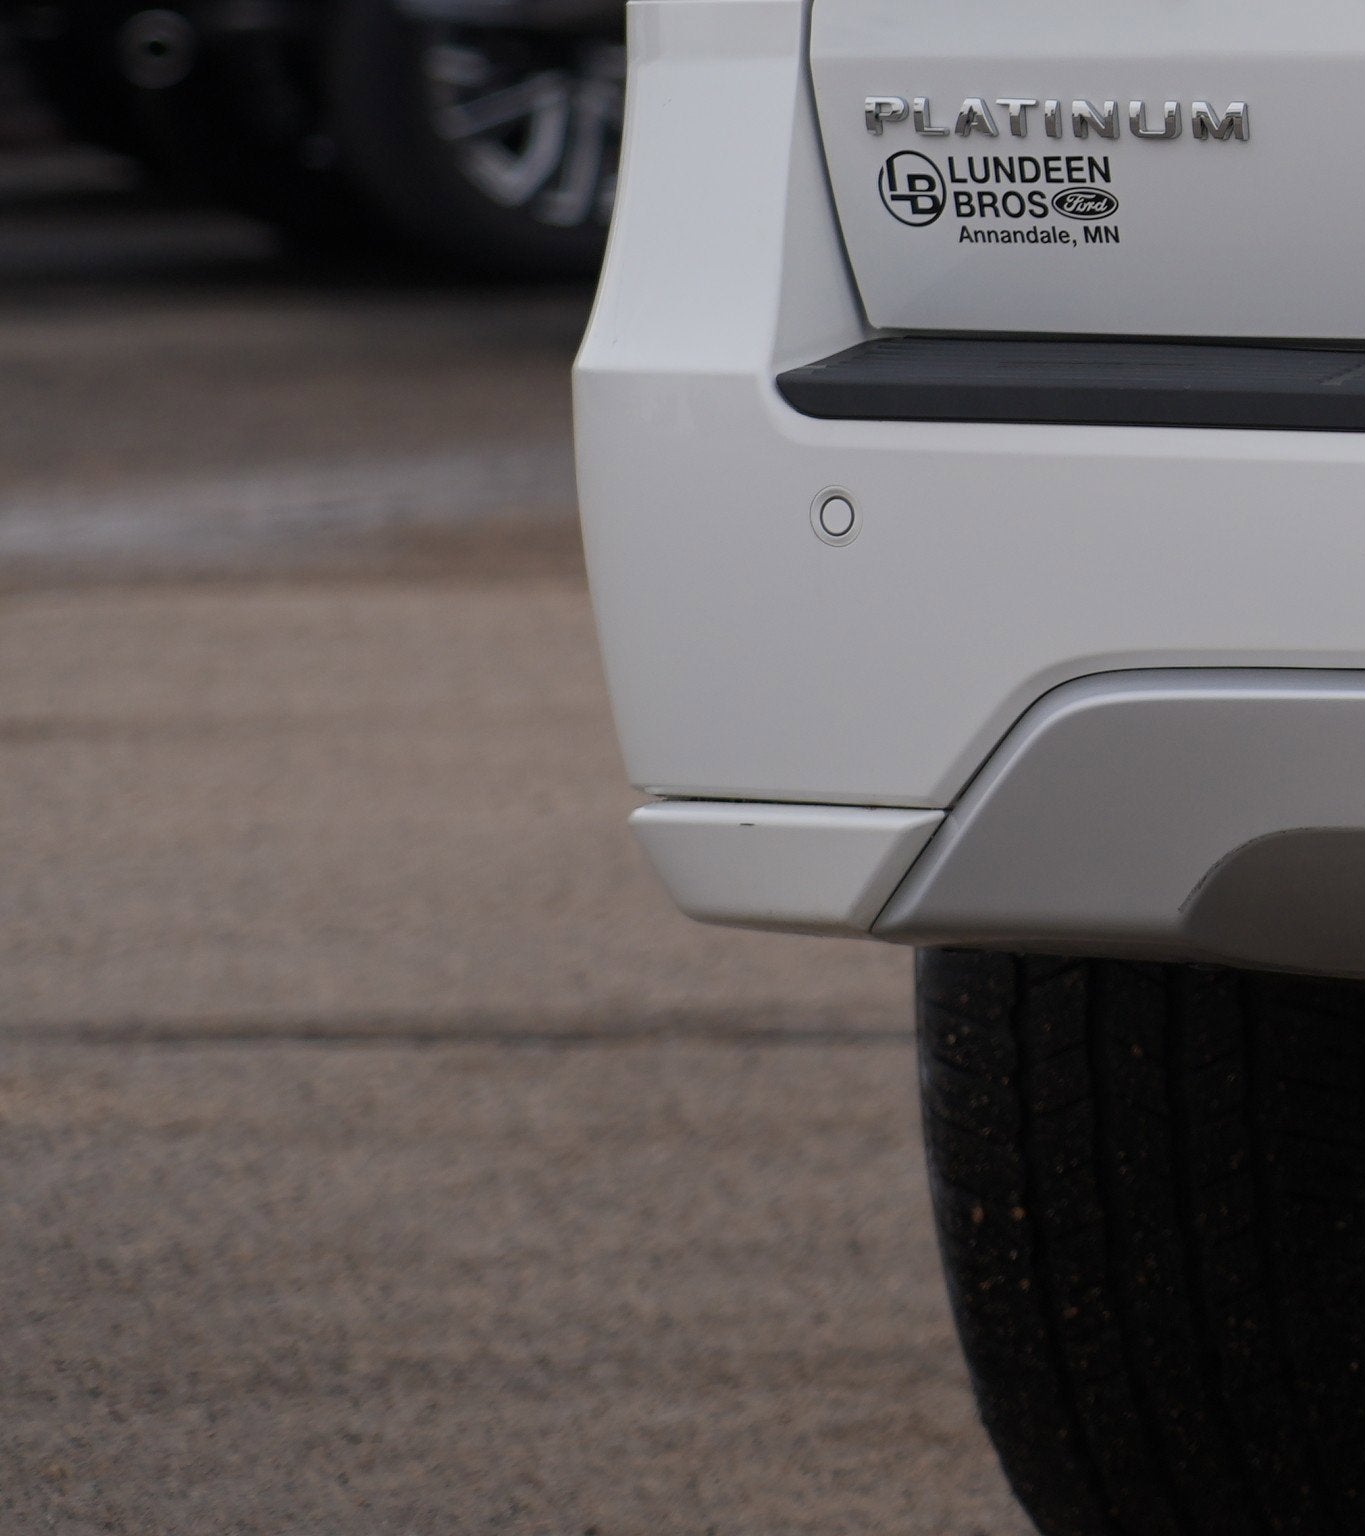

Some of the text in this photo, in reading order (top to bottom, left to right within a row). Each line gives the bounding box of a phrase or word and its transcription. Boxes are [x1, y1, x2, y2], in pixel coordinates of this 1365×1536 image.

[864, 96, 1250, 142] PLATINUM
[947, 155, 1112, 185] LUNDEEN
[953, 190, 1050, 219] BROS
[1063, 193, 1108, 212] Ford
[958, 225, 1121, 248] Annandale, MN
